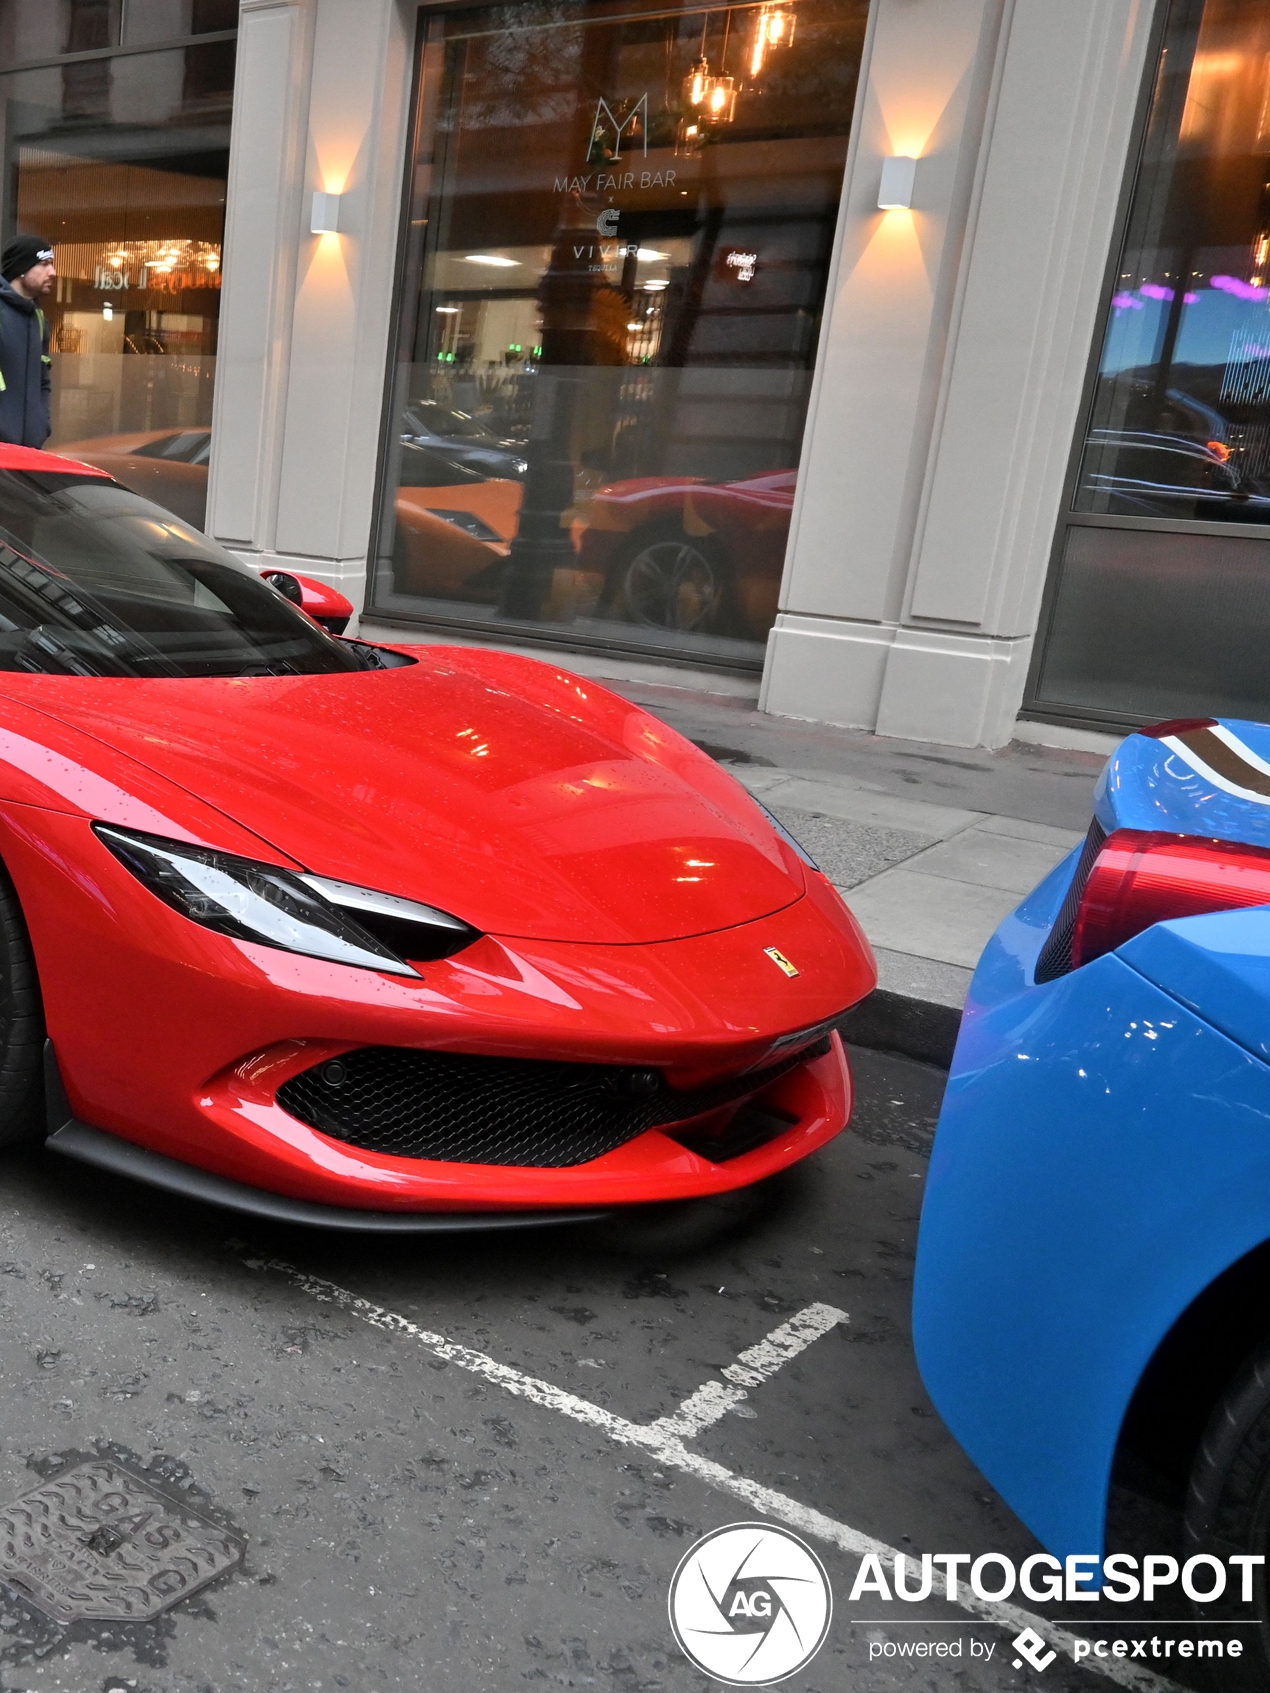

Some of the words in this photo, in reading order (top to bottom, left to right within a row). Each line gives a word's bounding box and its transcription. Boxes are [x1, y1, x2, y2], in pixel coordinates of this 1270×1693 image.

[553, 175, 592, 193] MAY
[596, 172, 634, 191] FAIR
[640, 170, 677, 189] BAR
[573, 244, 638, 259] VIVIR
[92, 1492, 181, 1549] GAS
[148, 1569, 187, 1598] G
